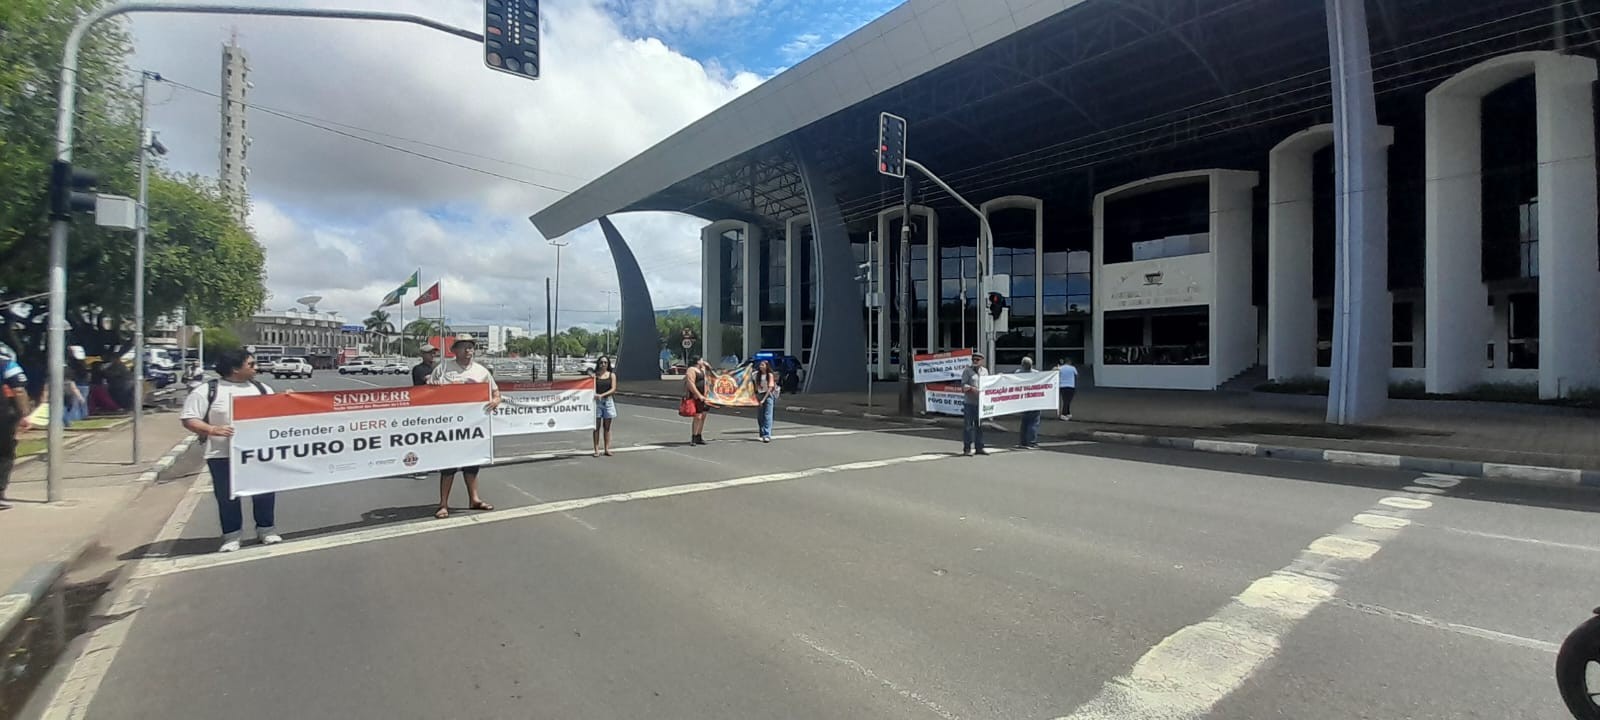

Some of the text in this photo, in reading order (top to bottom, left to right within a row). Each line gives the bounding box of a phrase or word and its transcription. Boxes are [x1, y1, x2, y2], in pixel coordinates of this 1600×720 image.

[333, 391, 411, 404] SINDUERR
[493, 404, 591, 416] STÊNCIA ESTUDANTIL
[269, 424, 334, 439] Defender
[337, 425, 345, 433] a
[350, 419, 387, 431] UERR
[391, 419, 398, 428] é
[402, 415, 453, 427] defender
[241, 427, 485, 464] FUTURO DE RORAIMA
